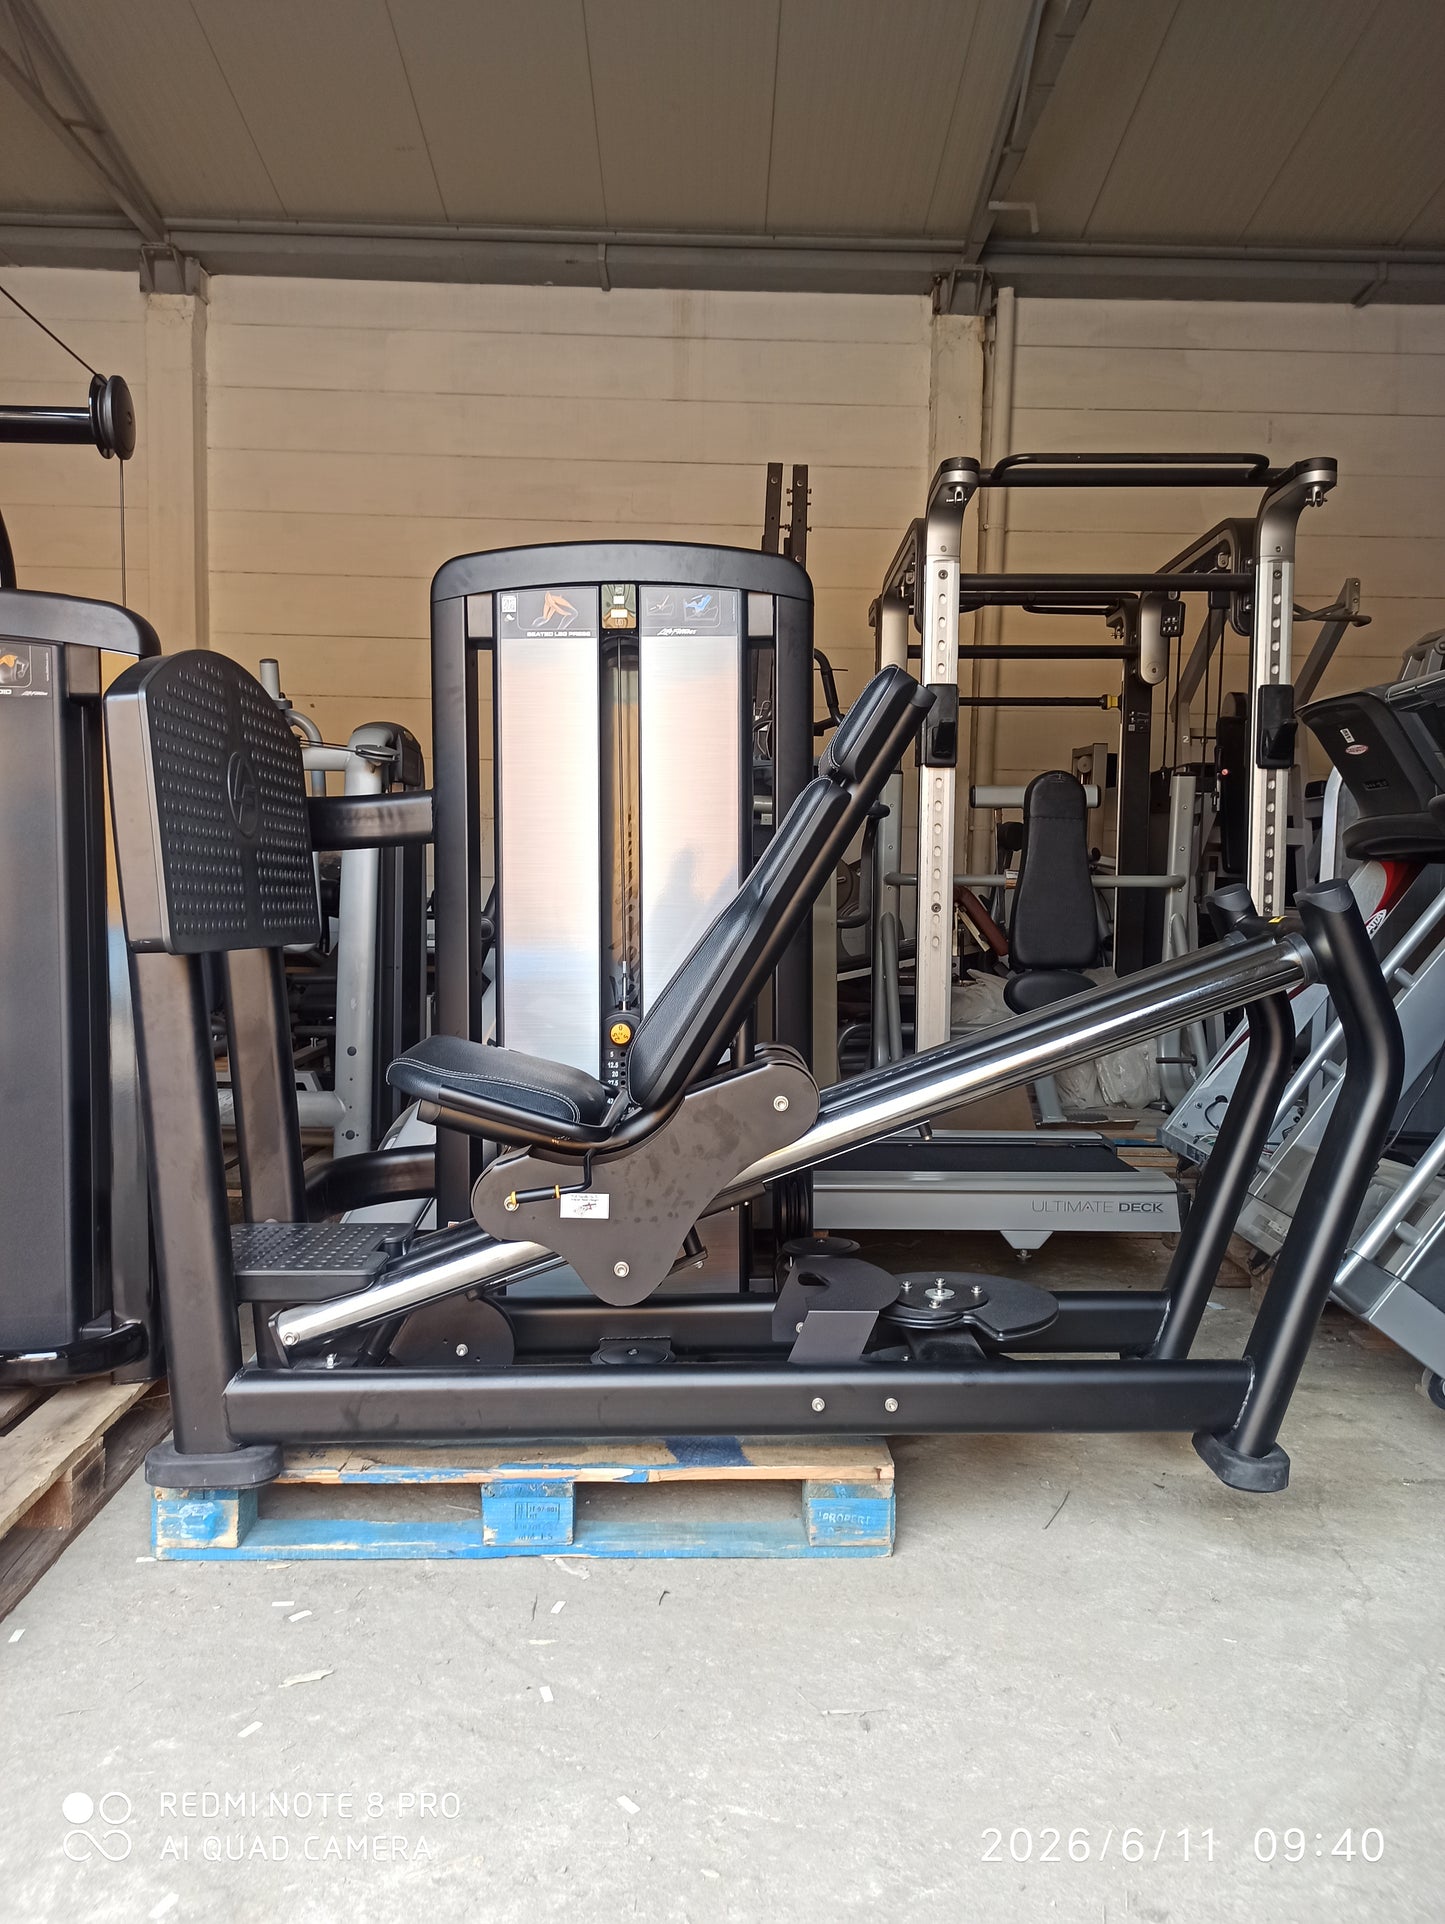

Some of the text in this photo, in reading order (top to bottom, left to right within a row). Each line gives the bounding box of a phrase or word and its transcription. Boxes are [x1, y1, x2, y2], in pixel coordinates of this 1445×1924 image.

[607, 1061, 619, 1069] 12.5
[611, 1070, 619, 1078] 20
[1031, 1200, 1164, 1213] ULTIMATE DECK
